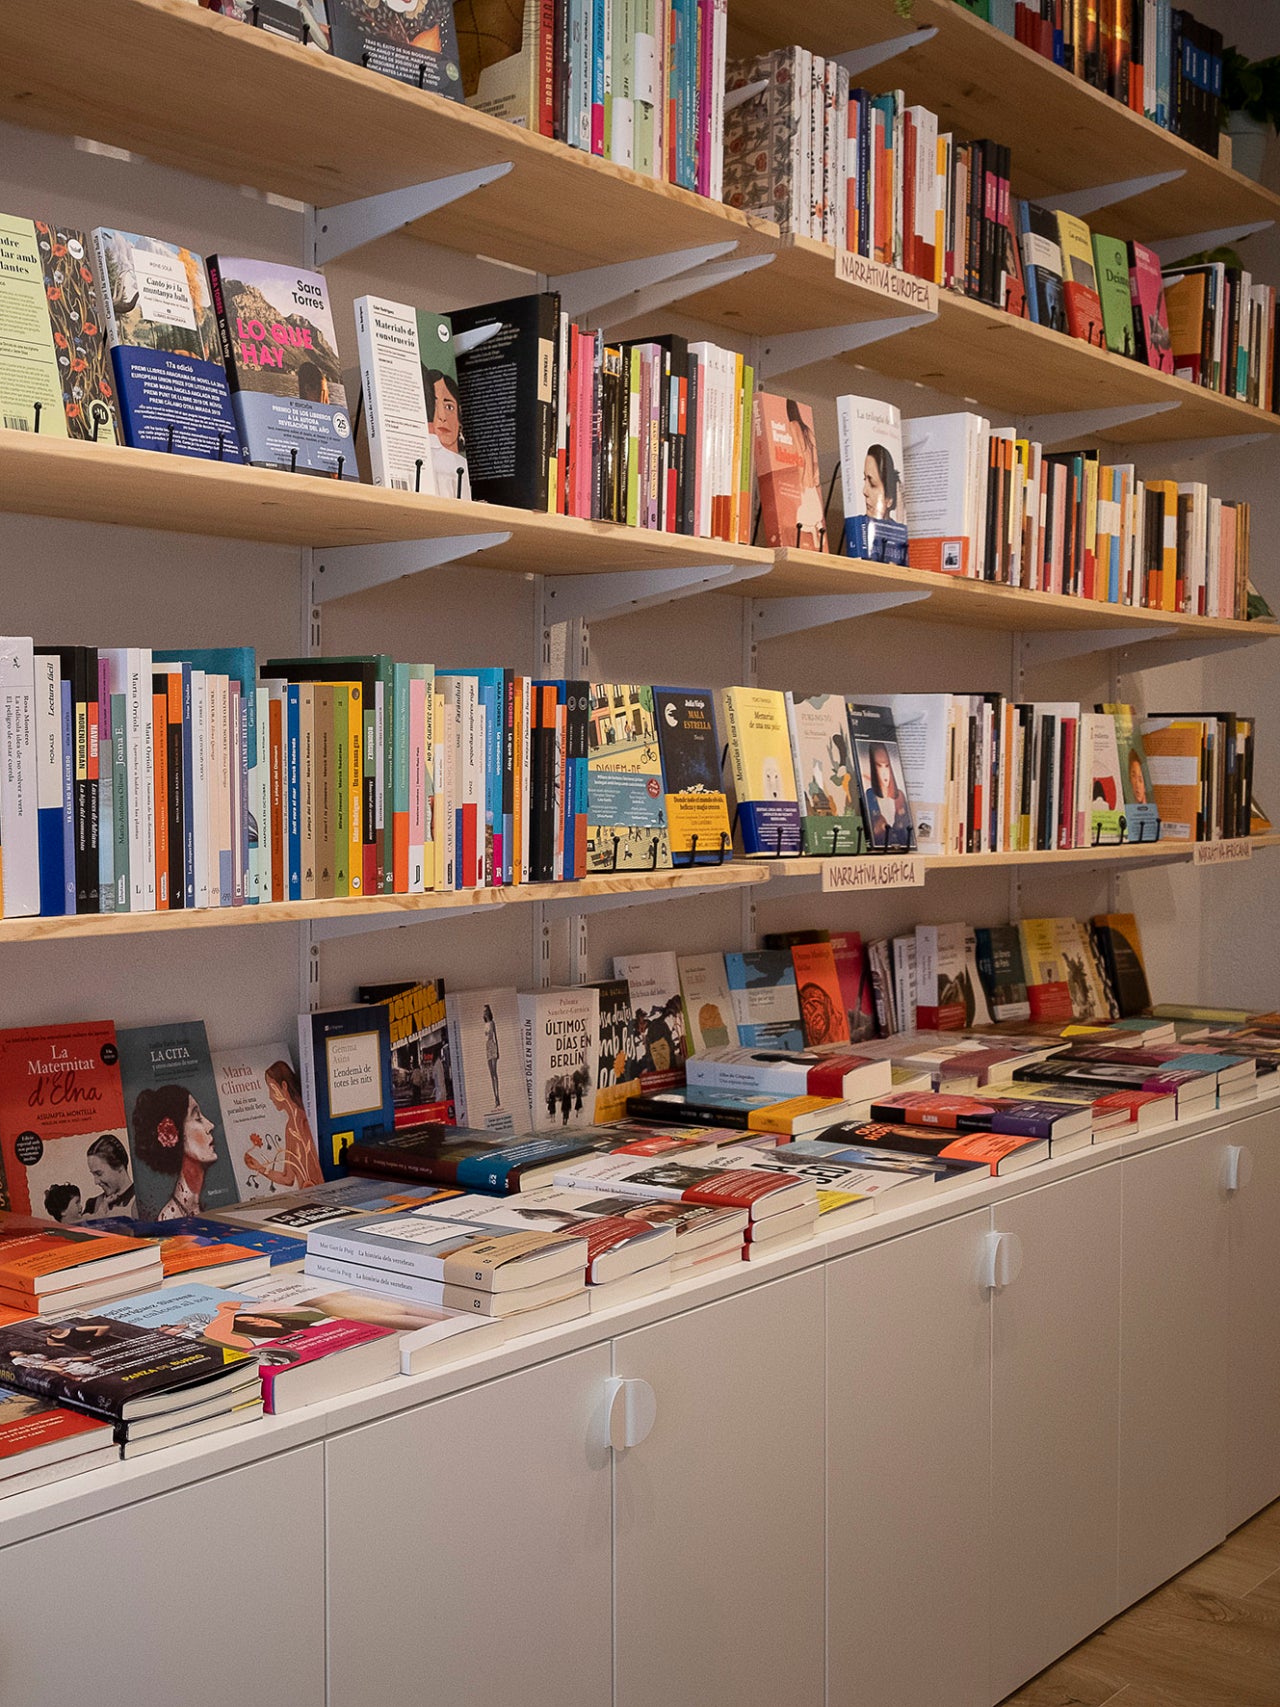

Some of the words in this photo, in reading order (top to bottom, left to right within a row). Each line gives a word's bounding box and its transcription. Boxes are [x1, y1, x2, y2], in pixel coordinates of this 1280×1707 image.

[17, 250, 38, 265] amb
[297, 280, 322, 297] Sara
[291, 292, 325, 311] Torres
[236, 318, 266, 341] LO
[271, 324, 314, 350] QUE
[374, 318, 406, 336] Materials
[375, 332, 415, 348] construcció
[241, 343, 285, 369] HAY
[336, 419, 347, 430] 25
[47, 662, 55, 681] fácil
[47, 682, 55, 717] Lectura
[726, 694, 735, 712] polar
[687, 710, 705, 720] MALA
[115, 724, 124, 735] E.
[683, 720, 712, 731] ESTRELLA
[90, 724, 98, 758] NAVARRO
[116, 737, 126, 767] Joana
[734, 749, 744, 782] Memorias
[525, 1019, 533, 1046] BERLÍN
[545, 1016, 587, 1037] ÚLTIMOS
[331, 1043, 358, 1055] Gemma
[556, 1032, 579, 1052] DÍAS
[580, 1033, 592, 1049] EN
[50, 1045, 69, 1060] La
[150, 1050, 167, 1063] LA
[167, 1047, 191, 1060] CITA
[525, 1046, 532, 1057] EN
[550, 1048, 585, 1069] BERLÍN
[27, 1058, 96, 1076] Maternitat
[222, 1064, 254, 1080] Maria
[333, 1066, 364, 1079] L'endemà
[364, 1065, 372, 1073] de
[525, 1057, 533, 1077] DÍAS
[27, 1069, 104, 1108] d'Elna
[221, 1079, 262, 1096] Climent
[333, 1079, 349, 1089] totes
[349, 1077, 359, 1086] les
[360, 1074, 373, 1084] nits
[36, 1111, 66, 1121] ASSUMPTA
[272, 1214, 294, 1224] La
[294, 1205, 335, 1219] plaça
[289, 1218, 308, 1228] del
[382, 1254, 393, 1262] dels
[392, 1256, 415, 1268] vertebrats
[389, 1279, 413, 1291] vertebrats
[120, 1366, 158, 1383] PANZA
[169, 1353, 205, 1368] BURRO
